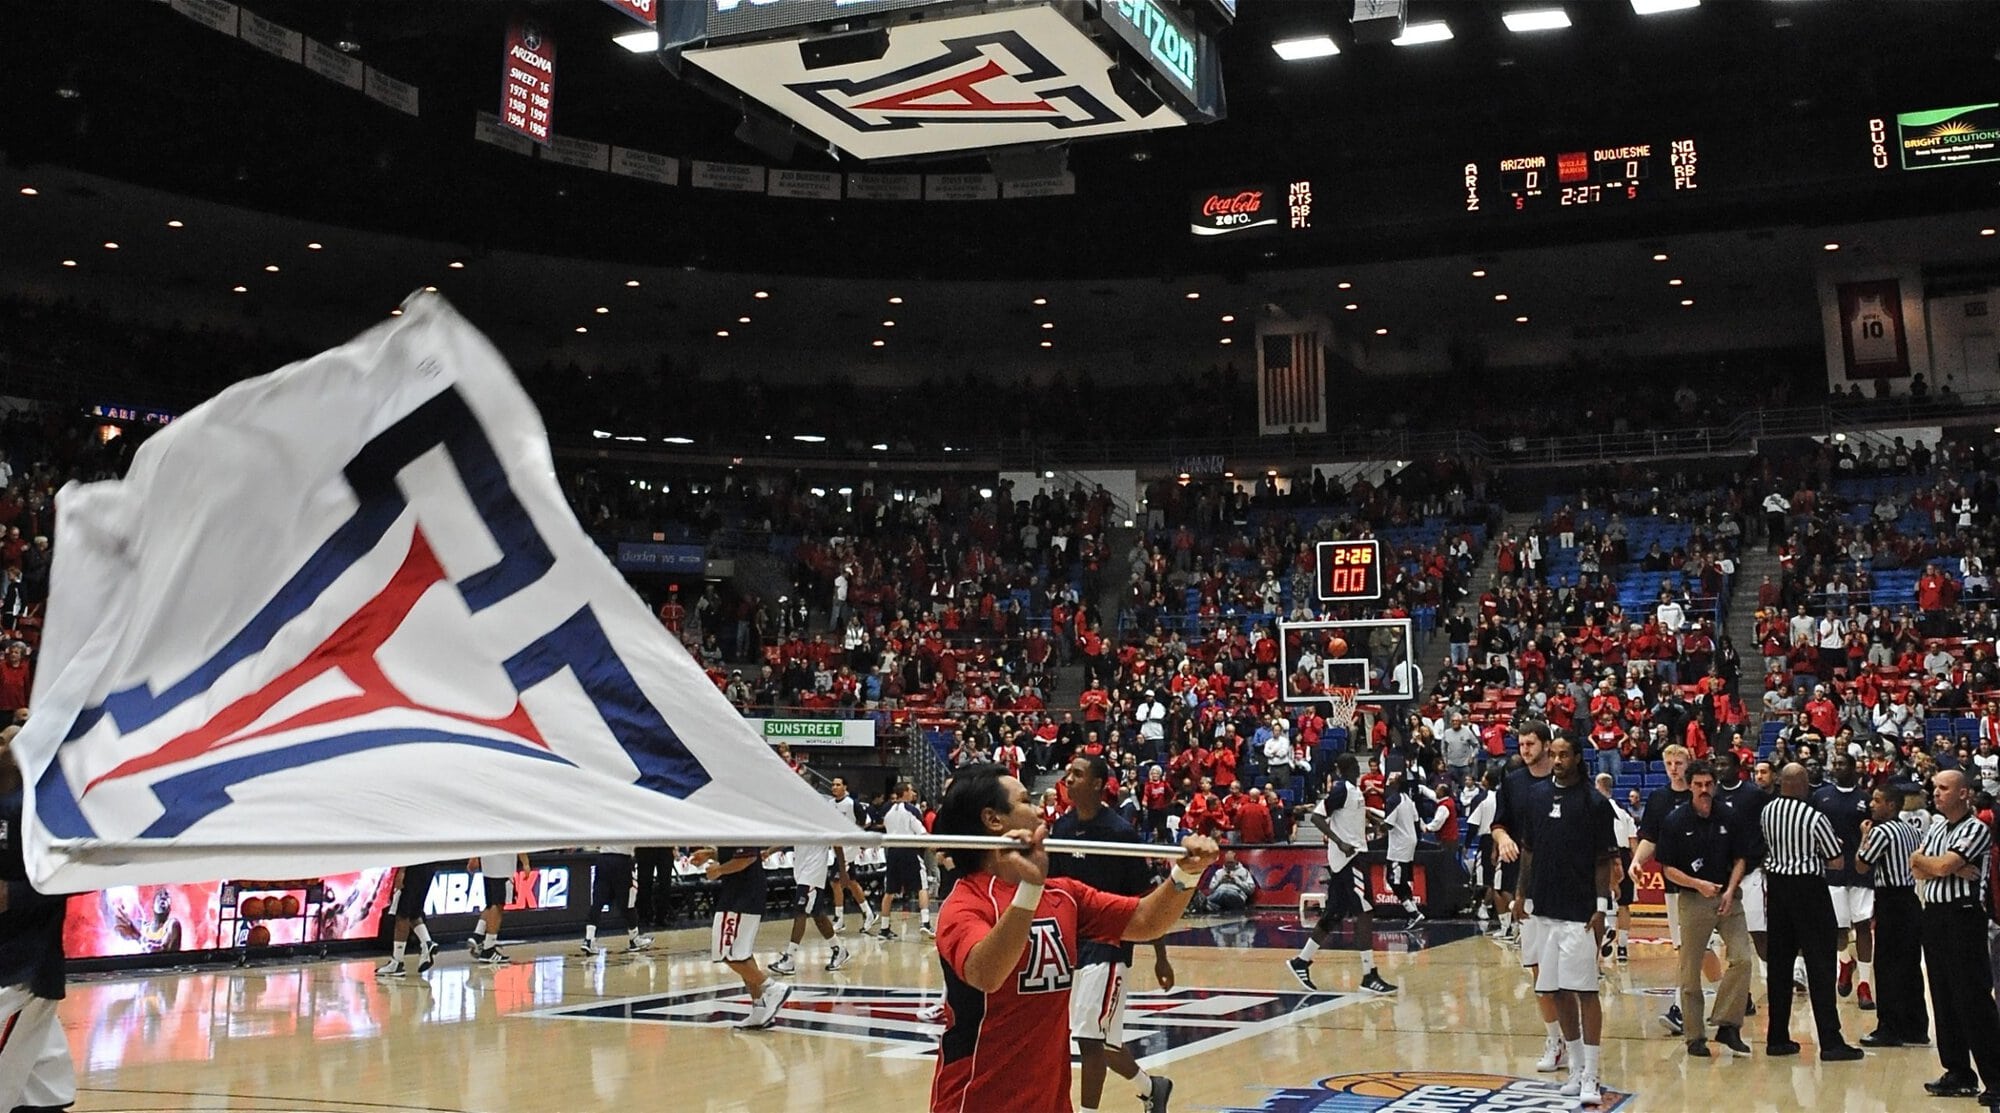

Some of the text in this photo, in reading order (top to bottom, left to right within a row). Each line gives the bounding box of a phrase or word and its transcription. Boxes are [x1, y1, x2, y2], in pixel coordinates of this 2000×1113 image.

[510, 45, 552, 73] ARIZONA
[510, 67, 549, 94] SWEET 16
[509, 83, 527, 99] 1976
[530, 107, 547, 123] 1991
[507, 112, 547, 137] 1994 1996
[1671, 140, 1694, 154] NO
[1904, 137, 1941, 149] BRIGHT
[1594, 145, 1651, 162] DUQUESNE
[1671, 152, 1697, 166] PTS
[1500, 156, 1545, 171] ARIZONA
[1626, 161, 1638, 179] 0
[1674, 164, 1696, 178] RB
[1290, 182, 1310, 194] NO
[1526, 171, 1538, 189] 0
[1675, 177, 1697, 190] FL
[1288, 193, 1312, 206] PTS
[1561, 185, 1601, 206] 2:27
[1291, 204, 1310, 217] RB
[1862, 320, 1884, 340] 10
[1335, 547, 1372, 565] 2:26
[1333, 567, 1365, 592] 00
[766, 722, 840, 736] SUNSTREET
[424, 869, 488, 917] NBA
[503, 868, 570, 912] K12
[1017, 916, 1075, 995] A
